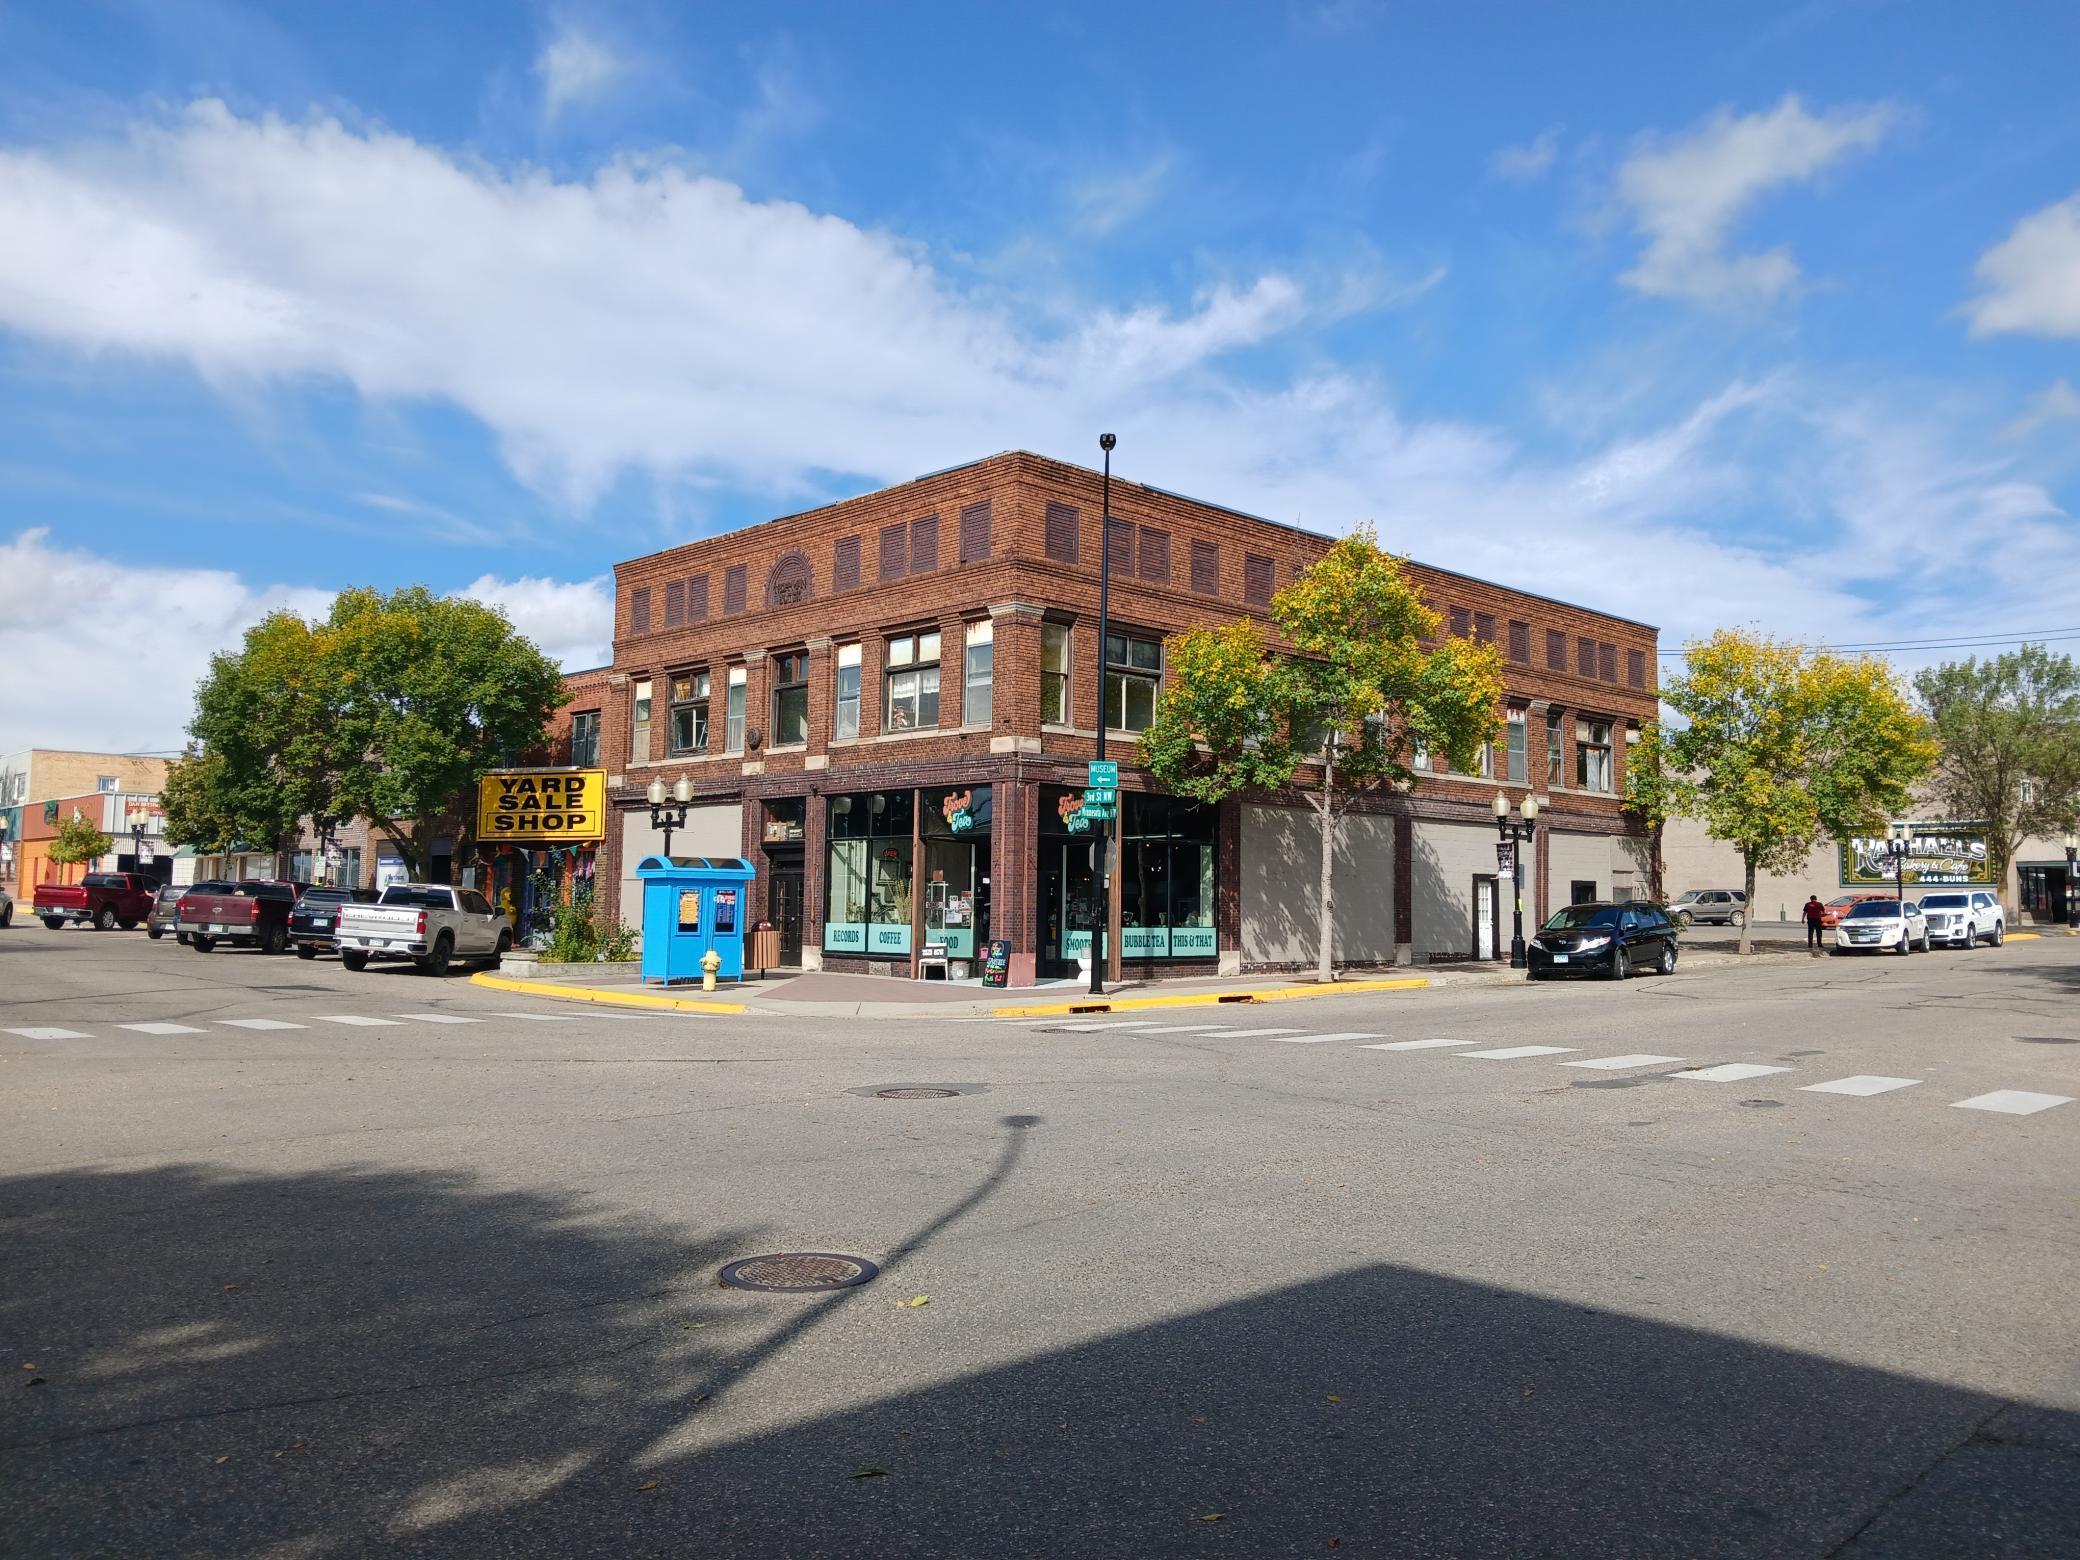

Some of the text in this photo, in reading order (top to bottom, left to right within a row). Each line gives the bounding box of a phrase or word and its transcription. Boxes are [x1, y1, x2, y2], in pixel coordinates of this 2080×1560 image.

[1090, 764, 1115, 773] MUSEUM
[499, 777, 586, 794] YARD
[498, 794, 584, 810] SALE
[1086, 791, 1113, 802] 3rd St NW
[494, 814, 587, 831] SHOP
[1931, 861, 1940, 870] &
[833, 930, 860, 943] RECORDS
[879, 931, 902, 944] COFFEE
[939, 936, 959, 949] FOOD
[1124, 935, 1165, 948] BUBBLE TEA
[1173, 935, 1213, 948] THIS & THAT
